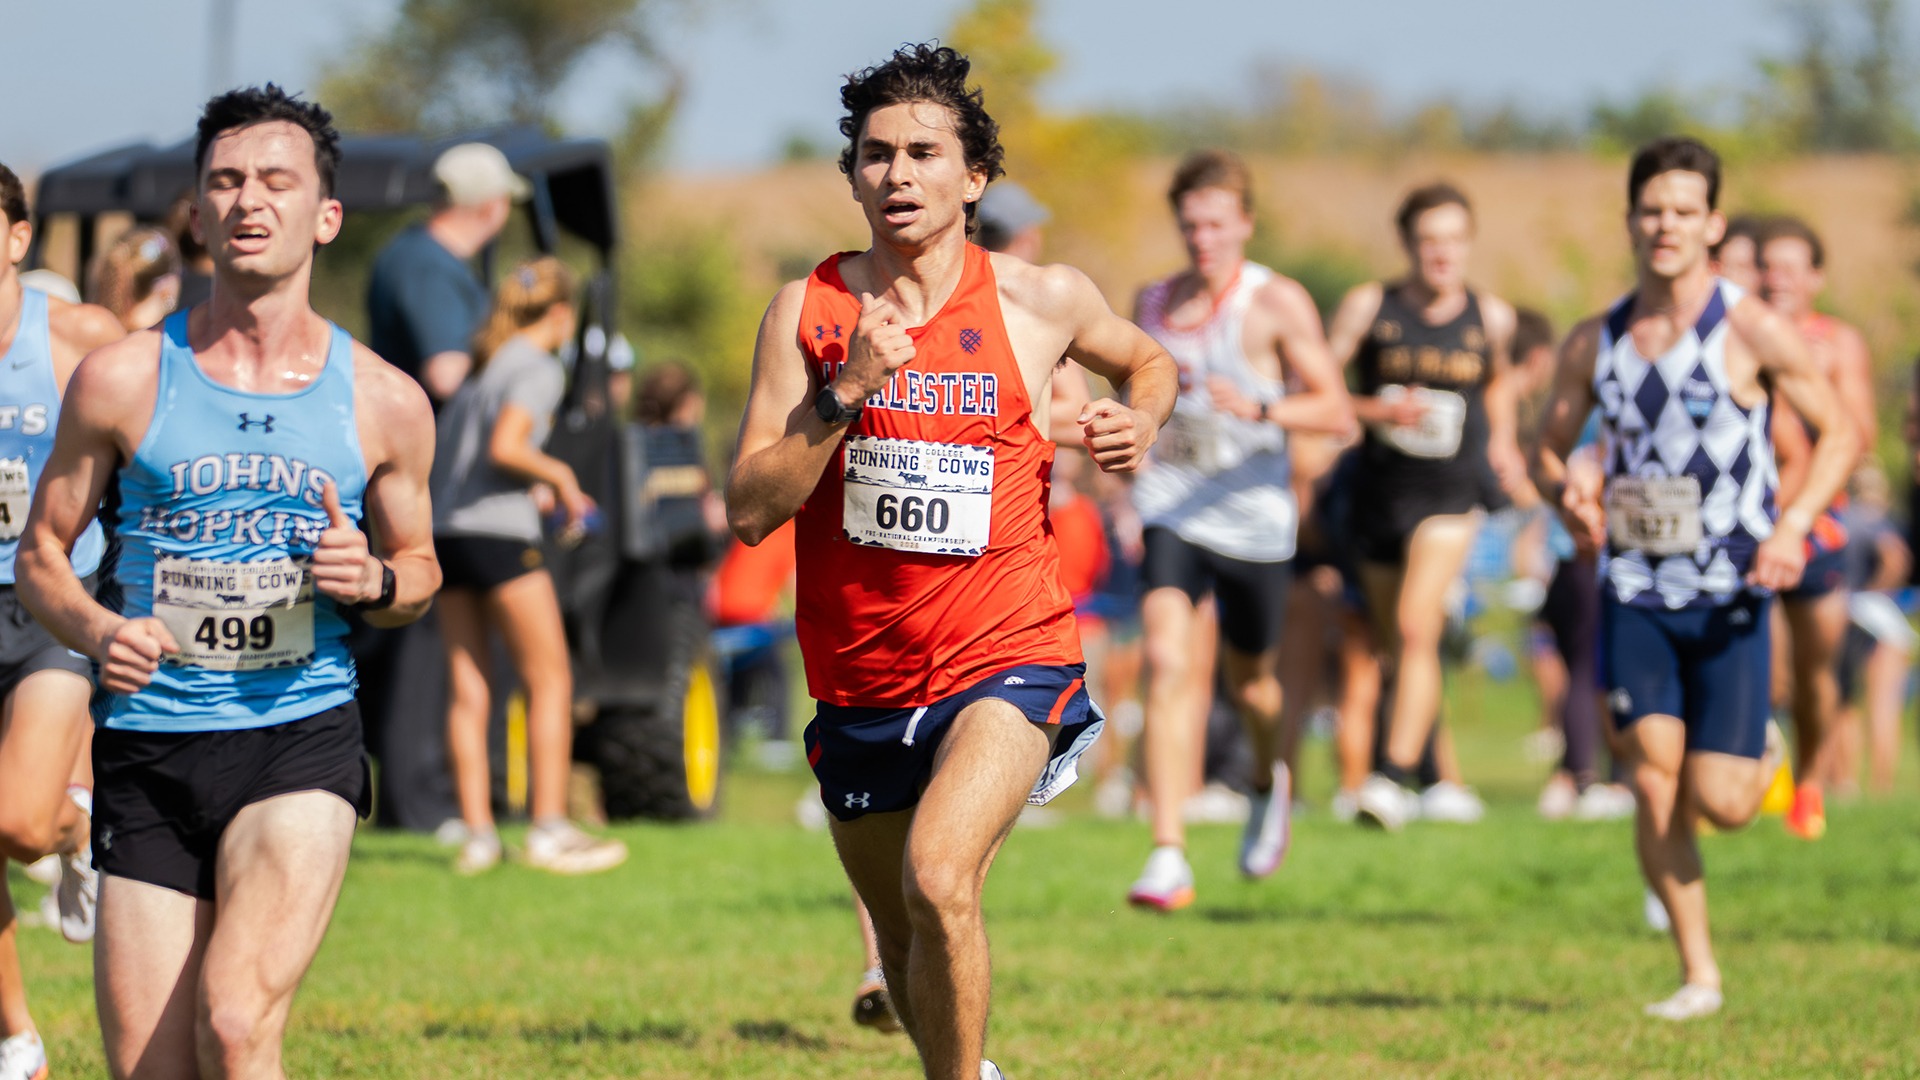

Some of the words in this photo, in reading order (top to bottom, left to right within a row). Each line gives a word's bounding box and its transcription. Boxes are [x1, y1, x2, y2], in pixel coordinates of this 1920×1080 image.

[849, 448, 919, 471] RUNNING
[938, 458, 990, 476] COWS
[873, 443, 921, 454] CARLETON
[925, 448, 964, 459] COLLEGE
[170, 453, 335, 508] JOHNS
[139, 505, 328, 545] HOPKIN
[876, 493, 950, 534] 660
[161, 570, 236, 591] RUNNING
[258, 570, 312, 589] COWS
[195, 616, 275, 650] 499
